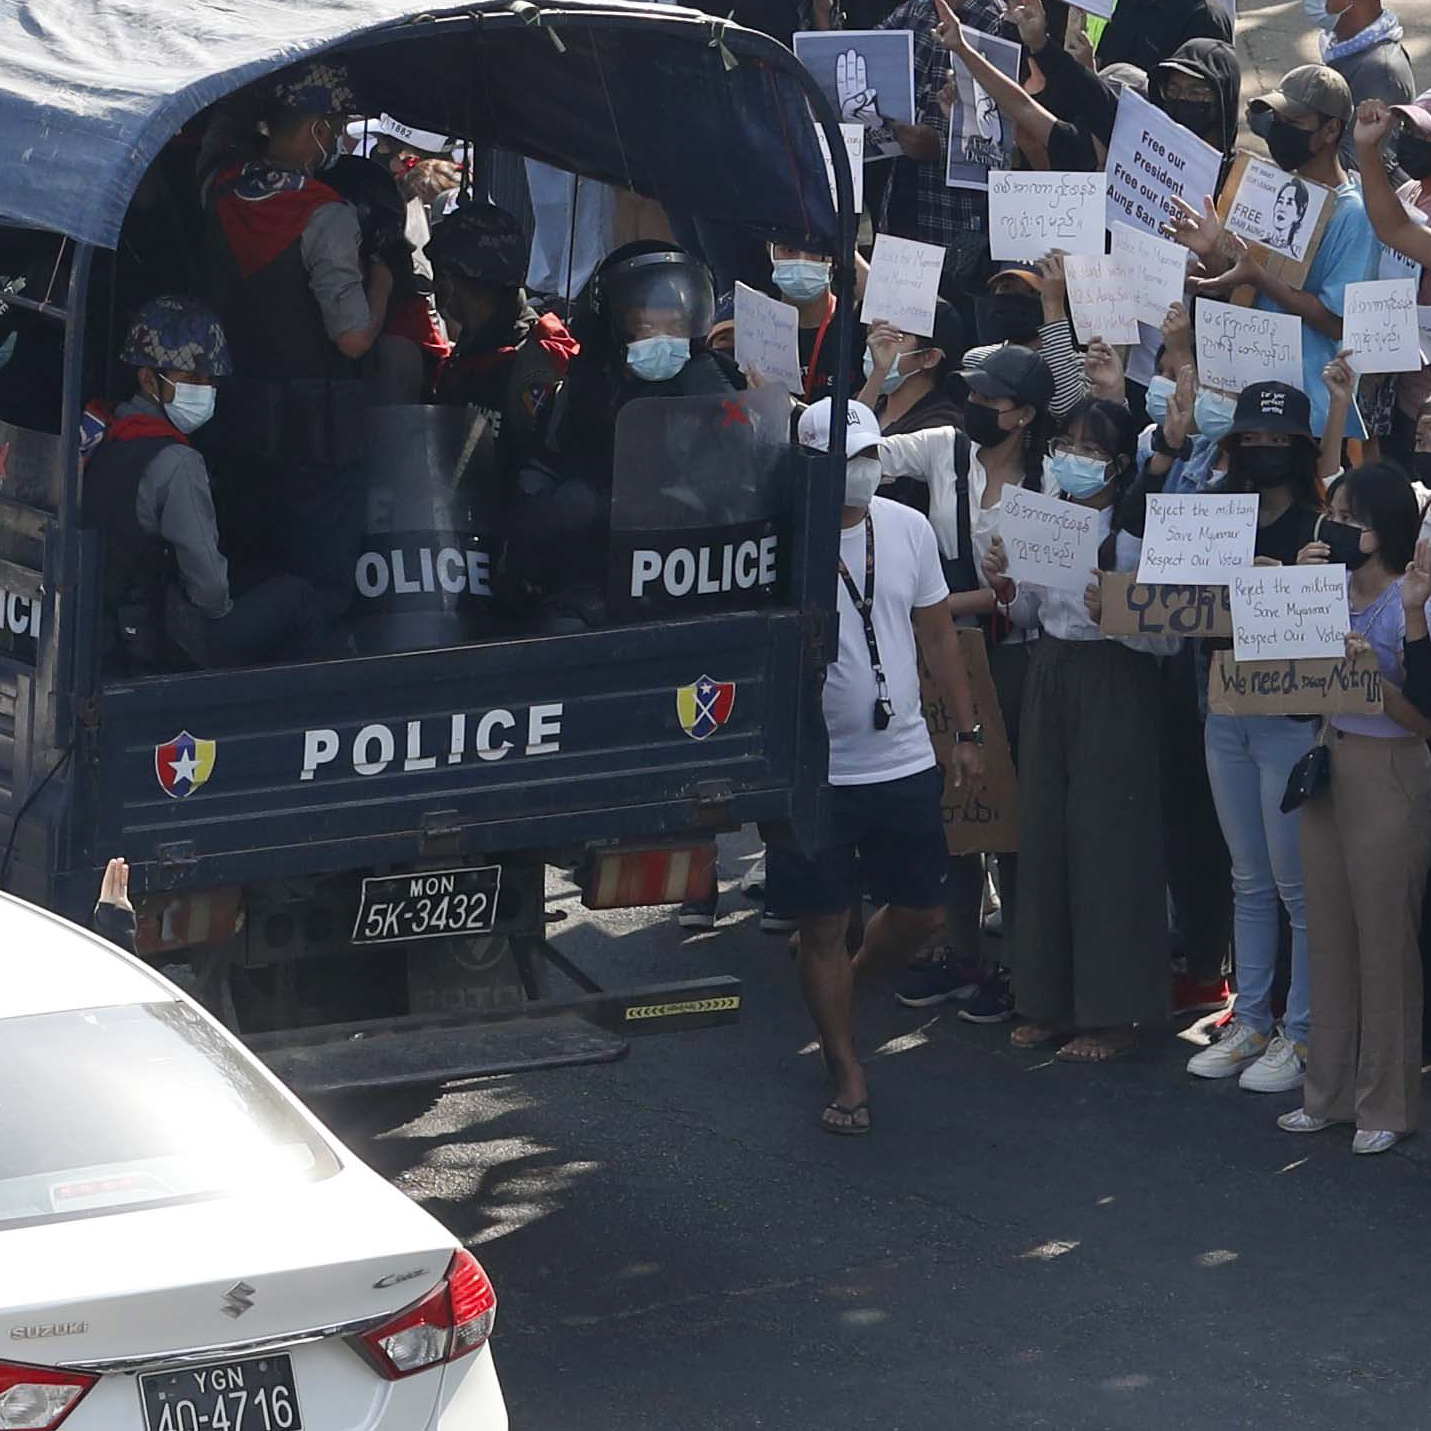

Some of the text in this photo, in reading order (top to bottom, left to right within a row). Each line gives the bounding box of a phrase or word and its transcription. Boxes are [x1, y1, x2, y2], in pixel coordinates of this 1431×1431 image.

[1140, 129, 1187, 171] Free our
[1114, 161, 1139, 190] Free
[1139, 183, 1159, 204] our
[1133, 150, 1185, 197] President
[1106, 184, 1134, 216] Aung
[1135, 203, 1156, 229] San
[1233, 202, 1263, 225] FREE
[1148, 498, 1185, 526] Reject
[1192, 498, 1210, 516] the
[1165, 524, 1194, 543] Save
[355, 546, 494, 599] OLICE
[630, 534, 779, 599] POLICE
[1145, 547, 1185, 572] Respect
[1190, 552, 1211, 567] Our
[1234, 575, 1265, 605] Reject
[1273, 576, 1291, 594] the
[1253, 601, 1282, 618] Save
[1285, 601, 1333, 628] Myanmar
[1236, 625, 1278, 655] Respect
[1283, 628, 1307, 643] Our
[1221, 663, 1247, 696] We
[1250, 659, 1299, 696] need
[300, 701, 564, 781] POLICE
[410, 875, 455, 897] MON
[364, 891, 488, 937] 5K-3432
[10, 1319, 89, 1341] SUZUKI
[193, 1366, 245, 1394] YGN
